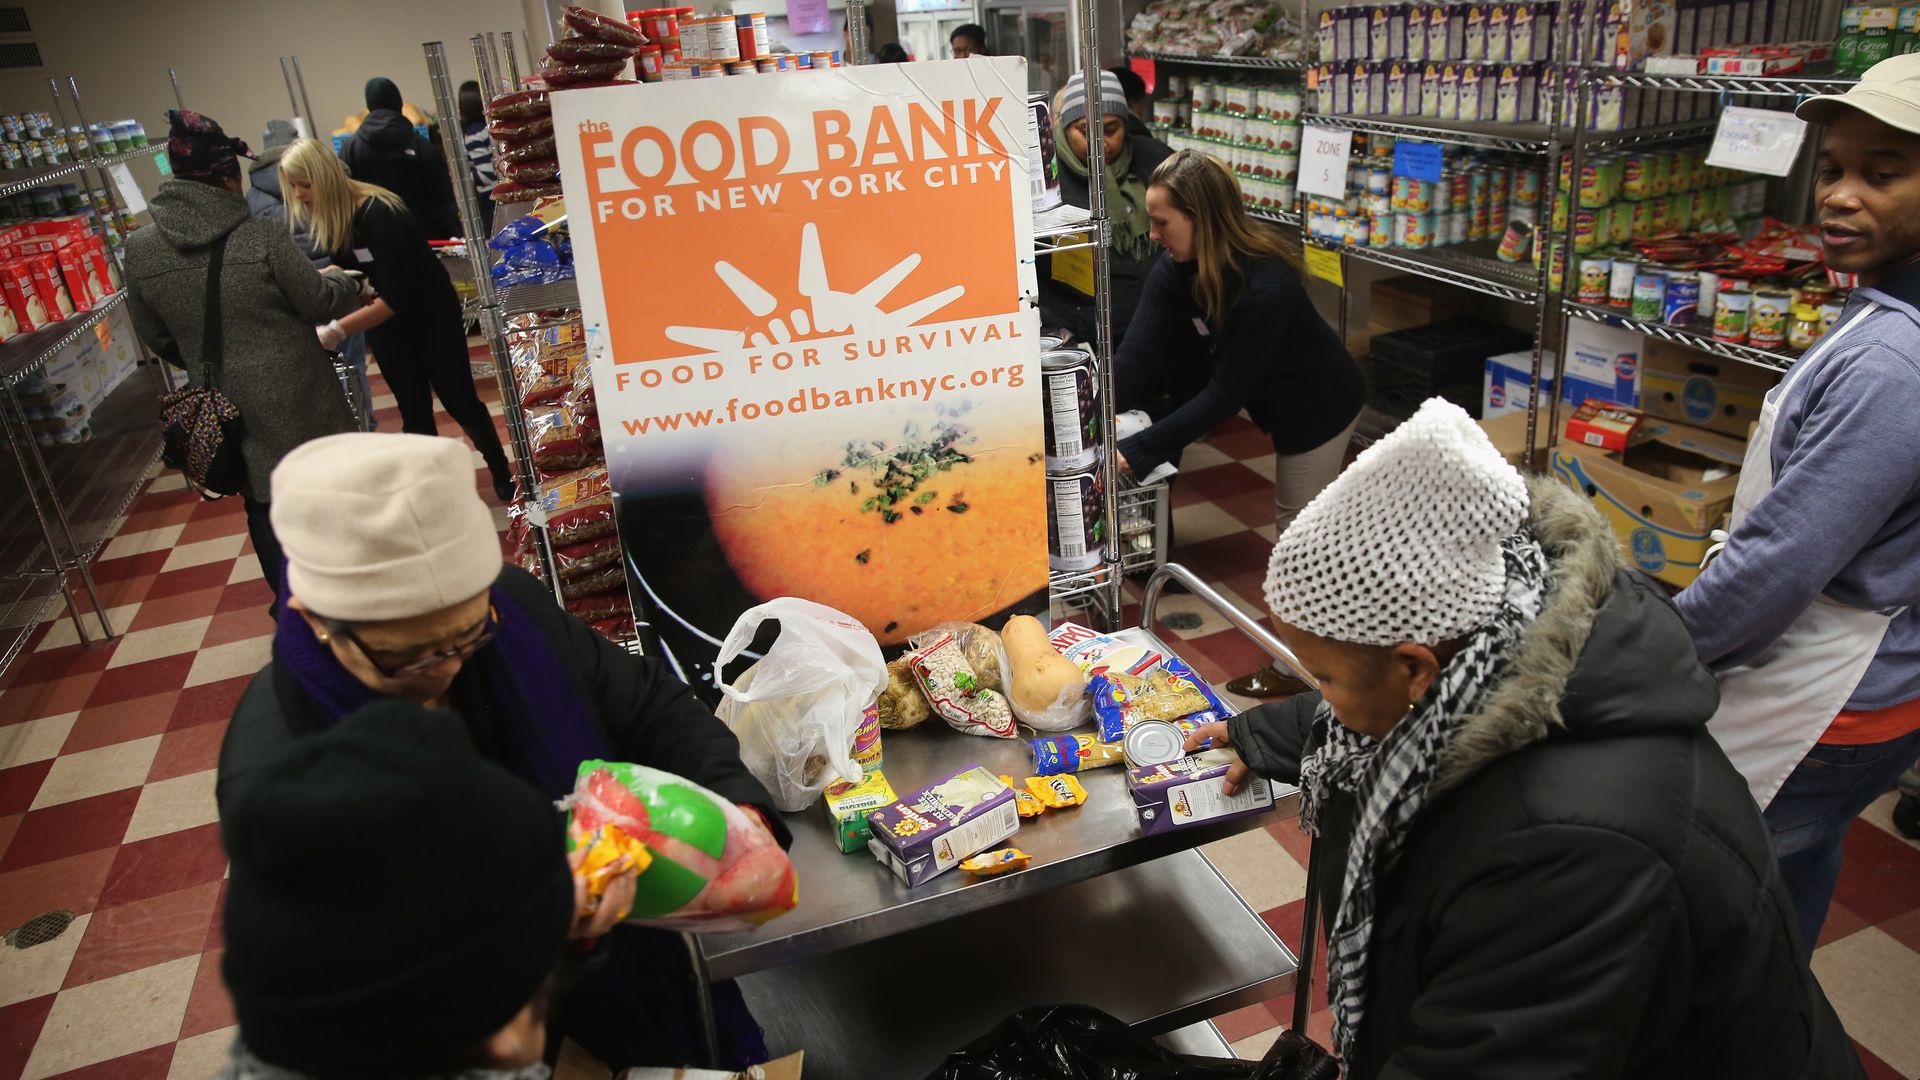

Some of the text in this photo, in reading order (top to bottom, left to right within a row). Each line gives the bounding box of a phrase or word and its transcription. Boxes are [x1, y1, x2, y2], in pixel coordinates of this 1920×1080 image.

[1857, 40, 1888, 52] Green
[1866, 50, 1881, 60] Tea
[577, 118, 610, 134] the
[579, 115, 790, 193] FOOD
[812, 97, 1008, 172] BANK
[1316, 140, 1342, 156] ZONE
[1322, 169, 1329, 182] 5
[598, 159, 1008, 223] FOR NEW YORK CITY
[616, 321, 1023, 392] FOOD FOR SURVIVAL
[622, 361, 1025, 436] www.foodbanknyc.org
[1050, 626, 1097, 654] AYPO
[895, 803, 937, 831] Borden
[1178, 790, 1193, 817] Borden
